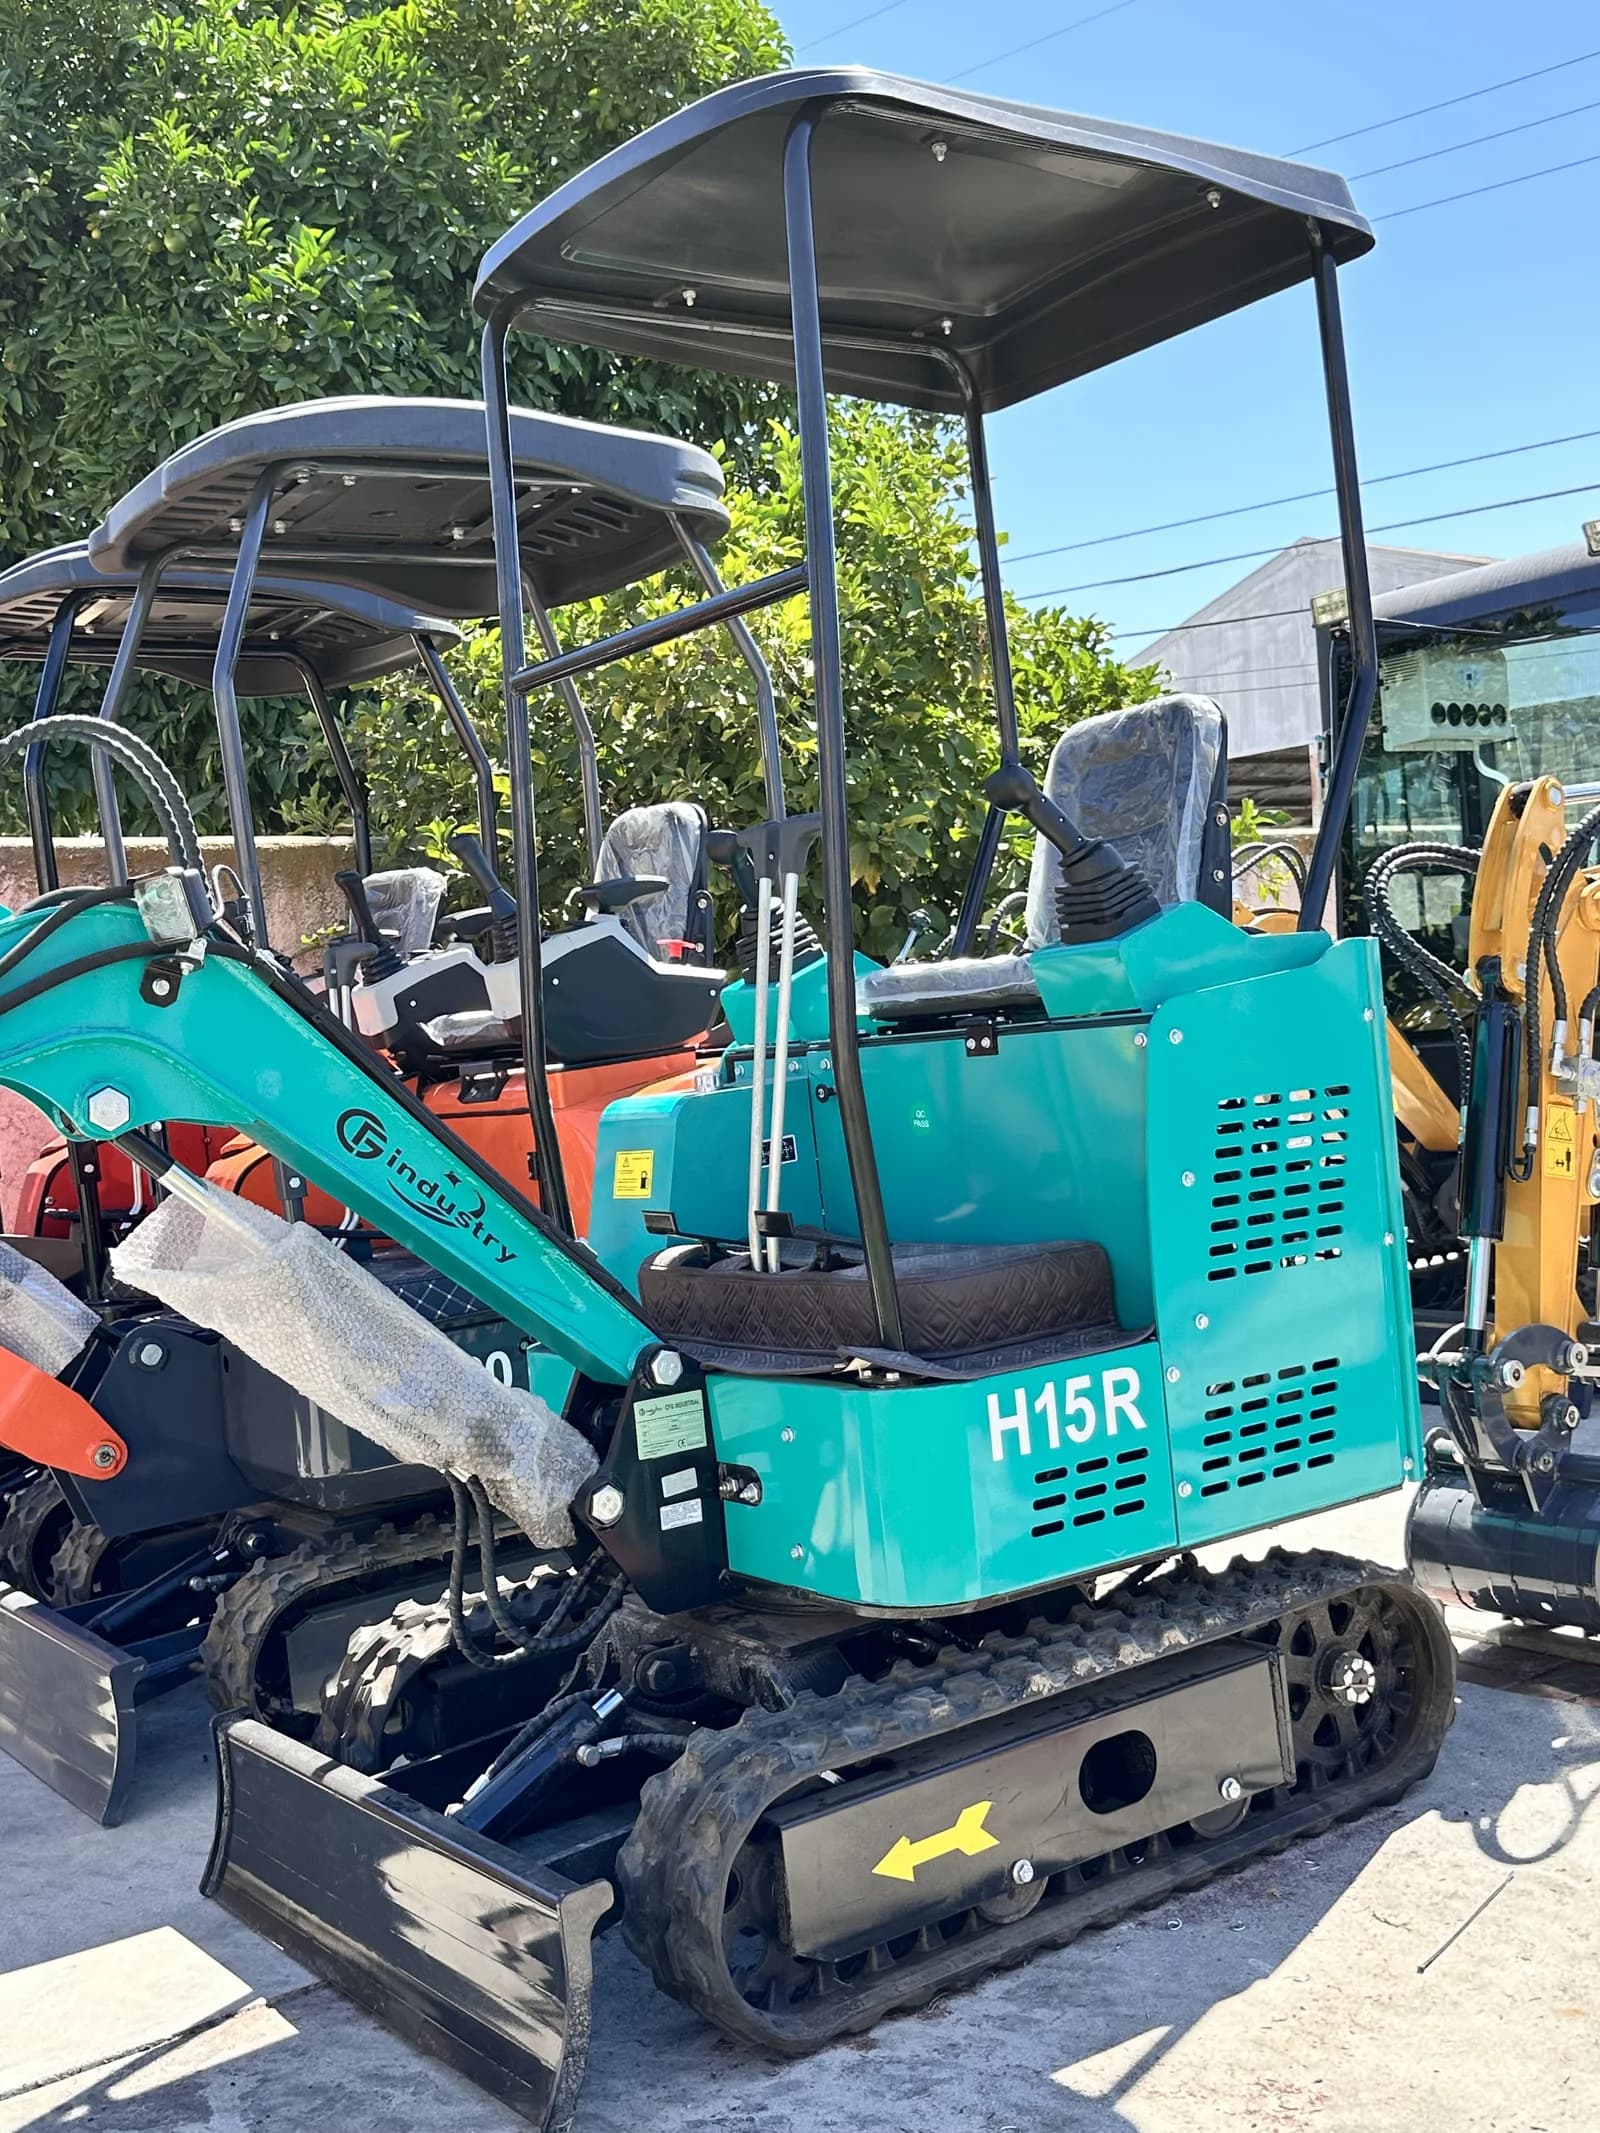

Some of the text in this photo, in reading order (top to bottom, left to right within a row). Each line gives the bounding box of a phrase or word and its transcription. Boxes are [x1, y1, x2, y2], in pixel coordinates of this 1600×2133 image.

[915, 1110, 926, 1118] QC
[913, 1119, 929, 1128] PASS
[986, 1366, 1148, 1462] H15R
